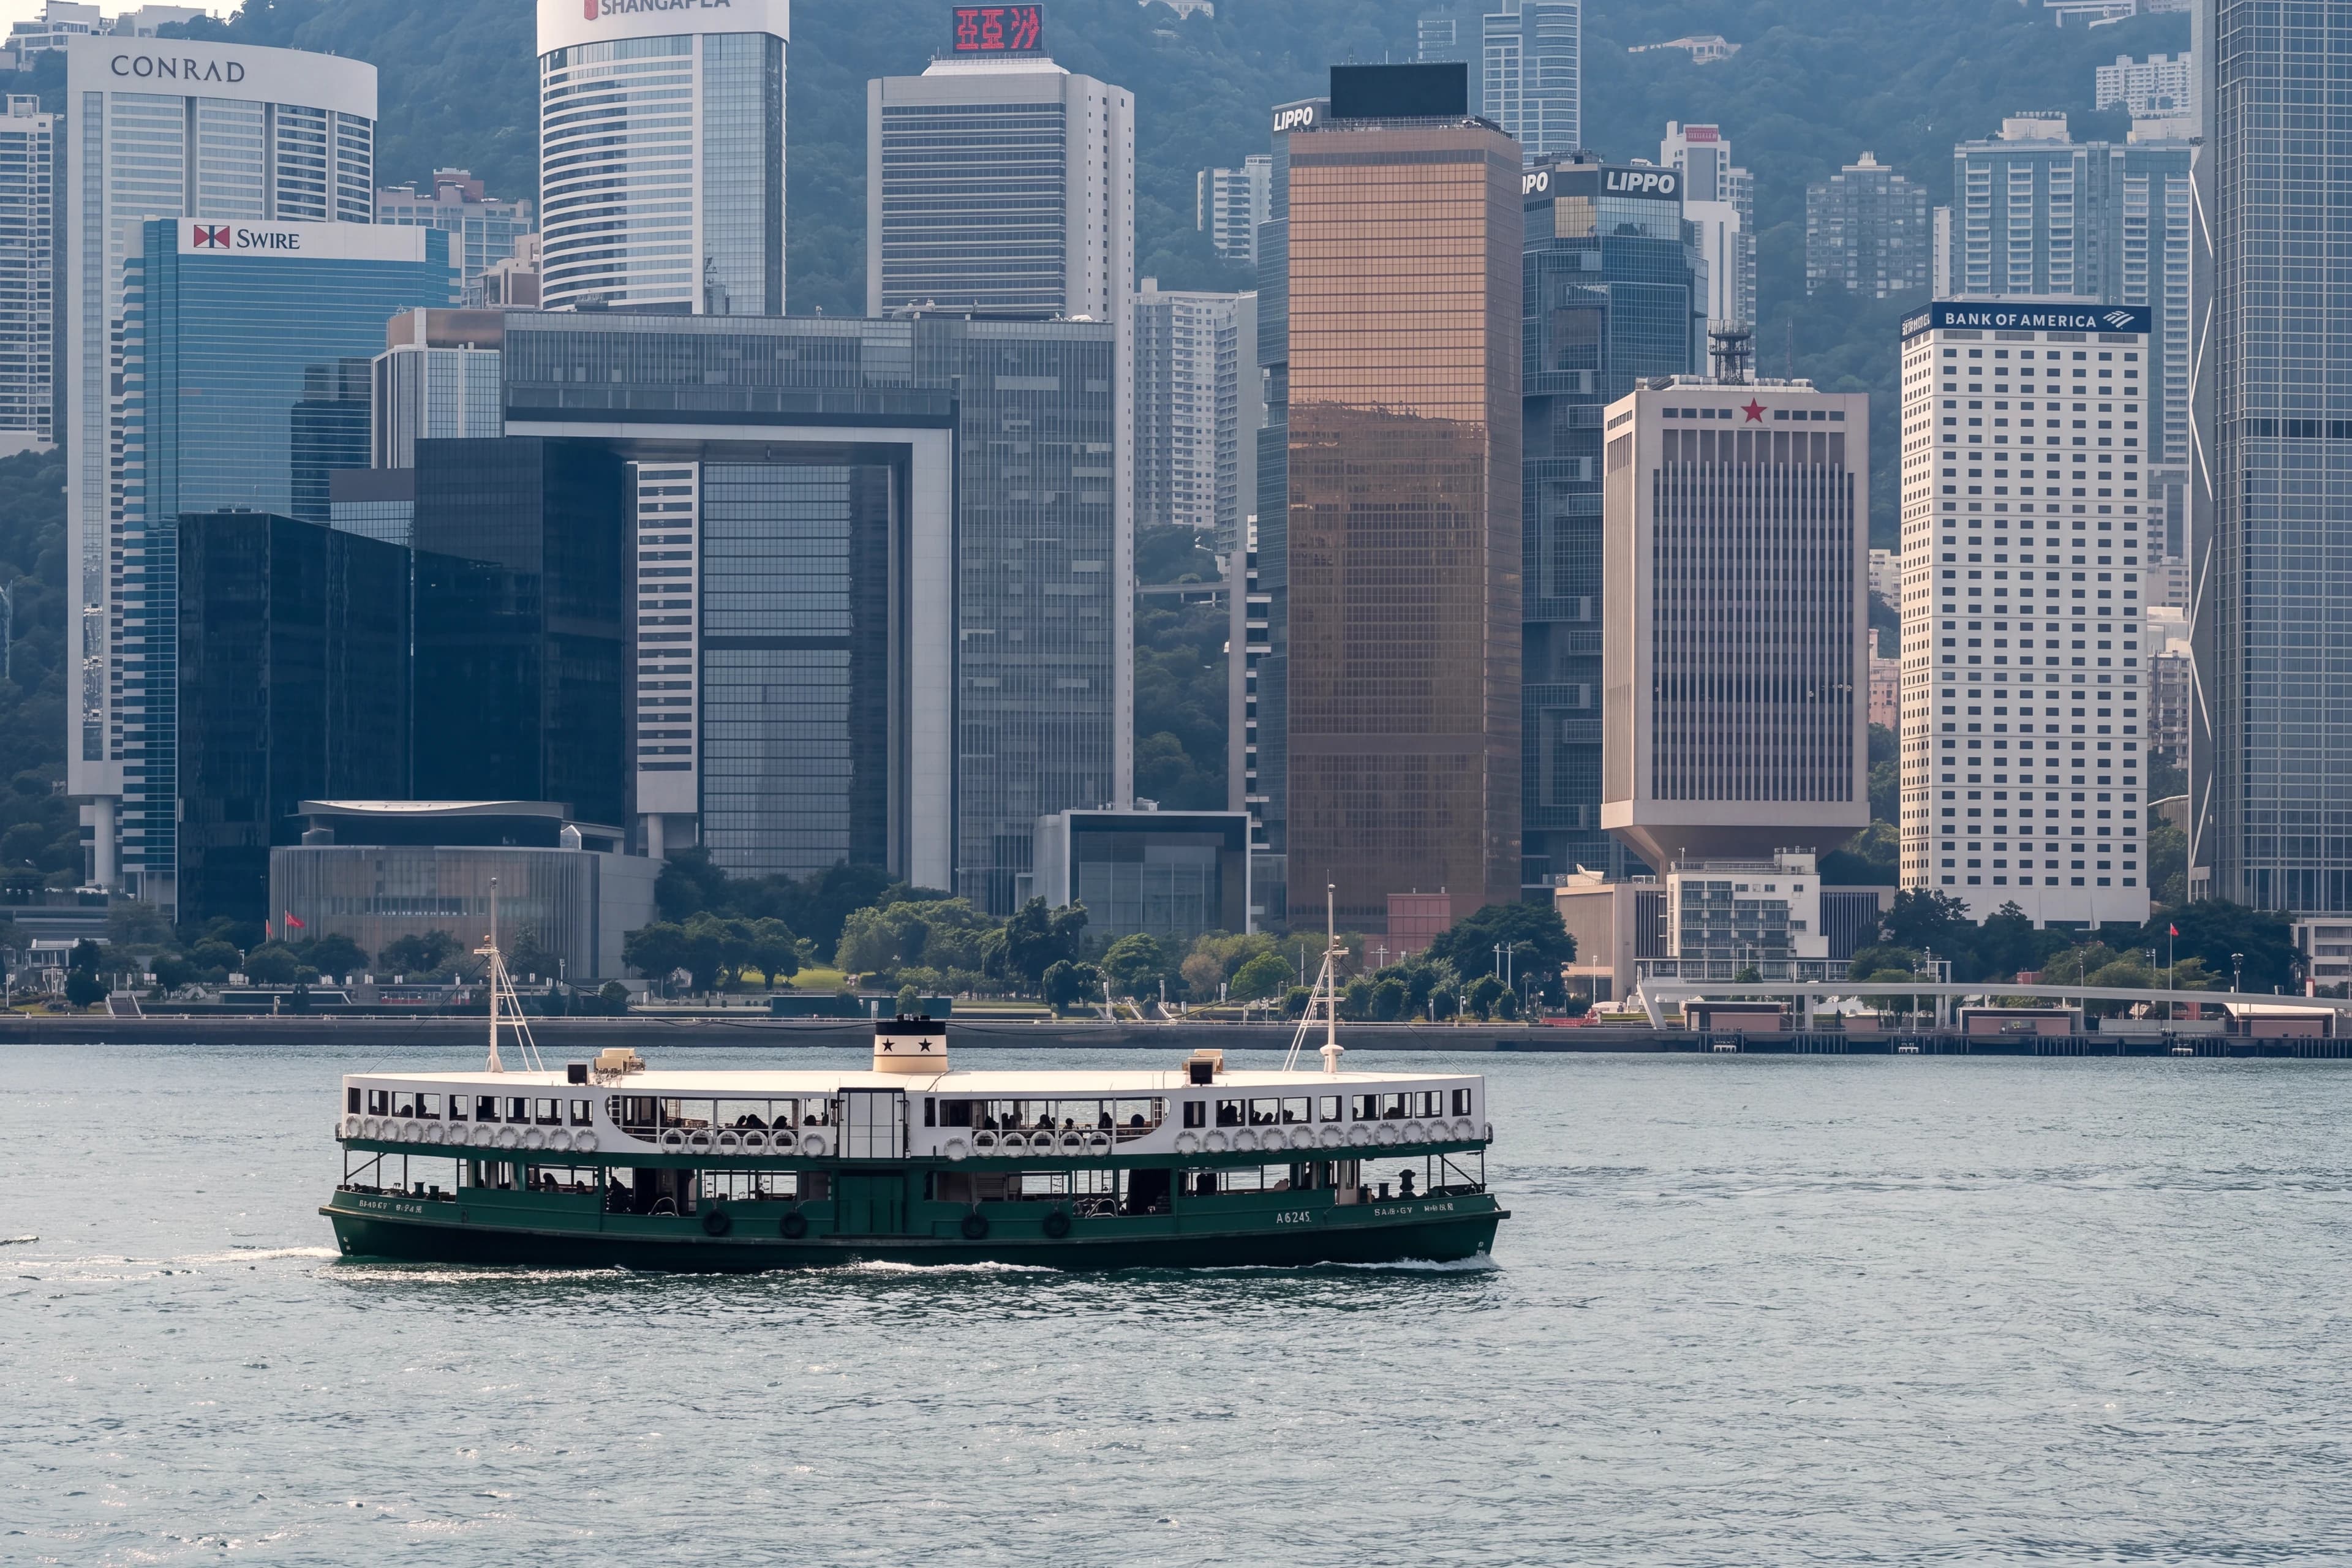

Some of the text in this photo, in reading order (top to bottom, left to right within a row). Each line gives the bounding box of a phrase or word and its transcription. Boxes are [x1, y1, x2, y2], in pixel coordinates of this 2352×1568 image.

[111, 55, 245, 83] CONRAD
[1273, 107, 1313, 132] LIPPO
[1607, 172, 1675, 194] LIPPO
[1945, 313, 2097, 328] BANK OF AMERICA
